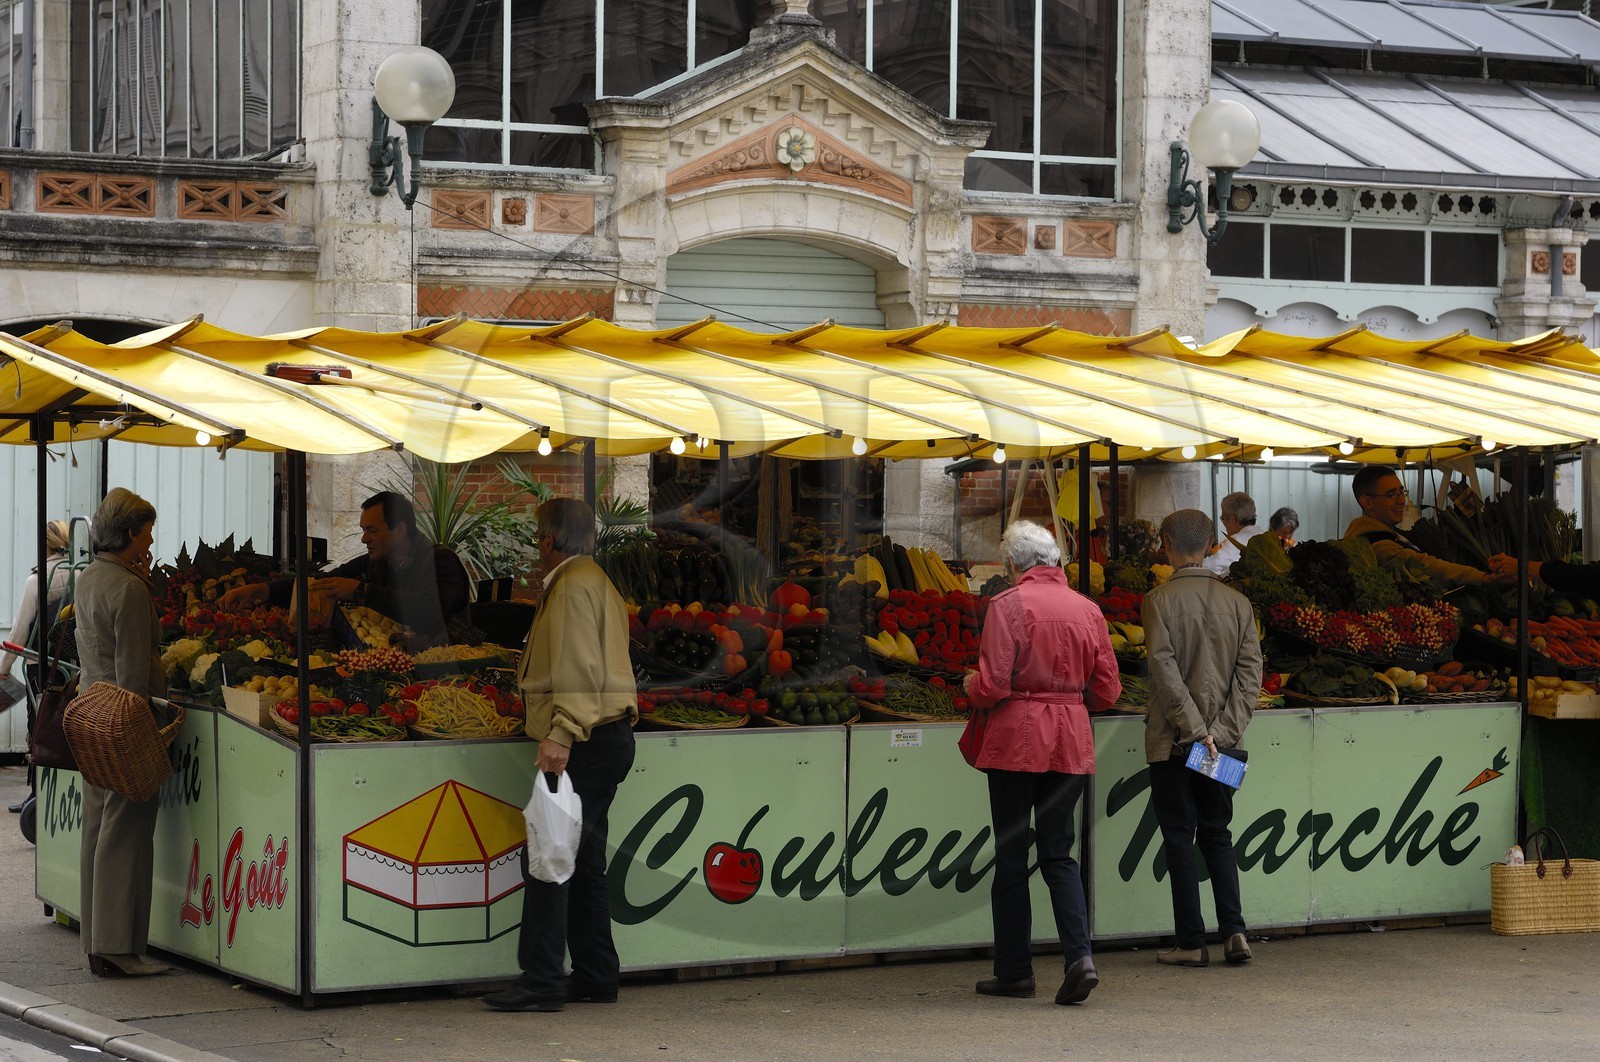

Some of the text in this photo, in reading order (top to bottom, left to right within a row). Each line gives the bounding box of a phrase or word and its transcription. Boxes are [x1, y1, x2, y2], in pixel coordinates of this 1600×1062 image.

[41, 767, 83, 838] Notr
[605, 784, 1042, 925] Couleu
[180, 826, 288, 948] Le Goût
